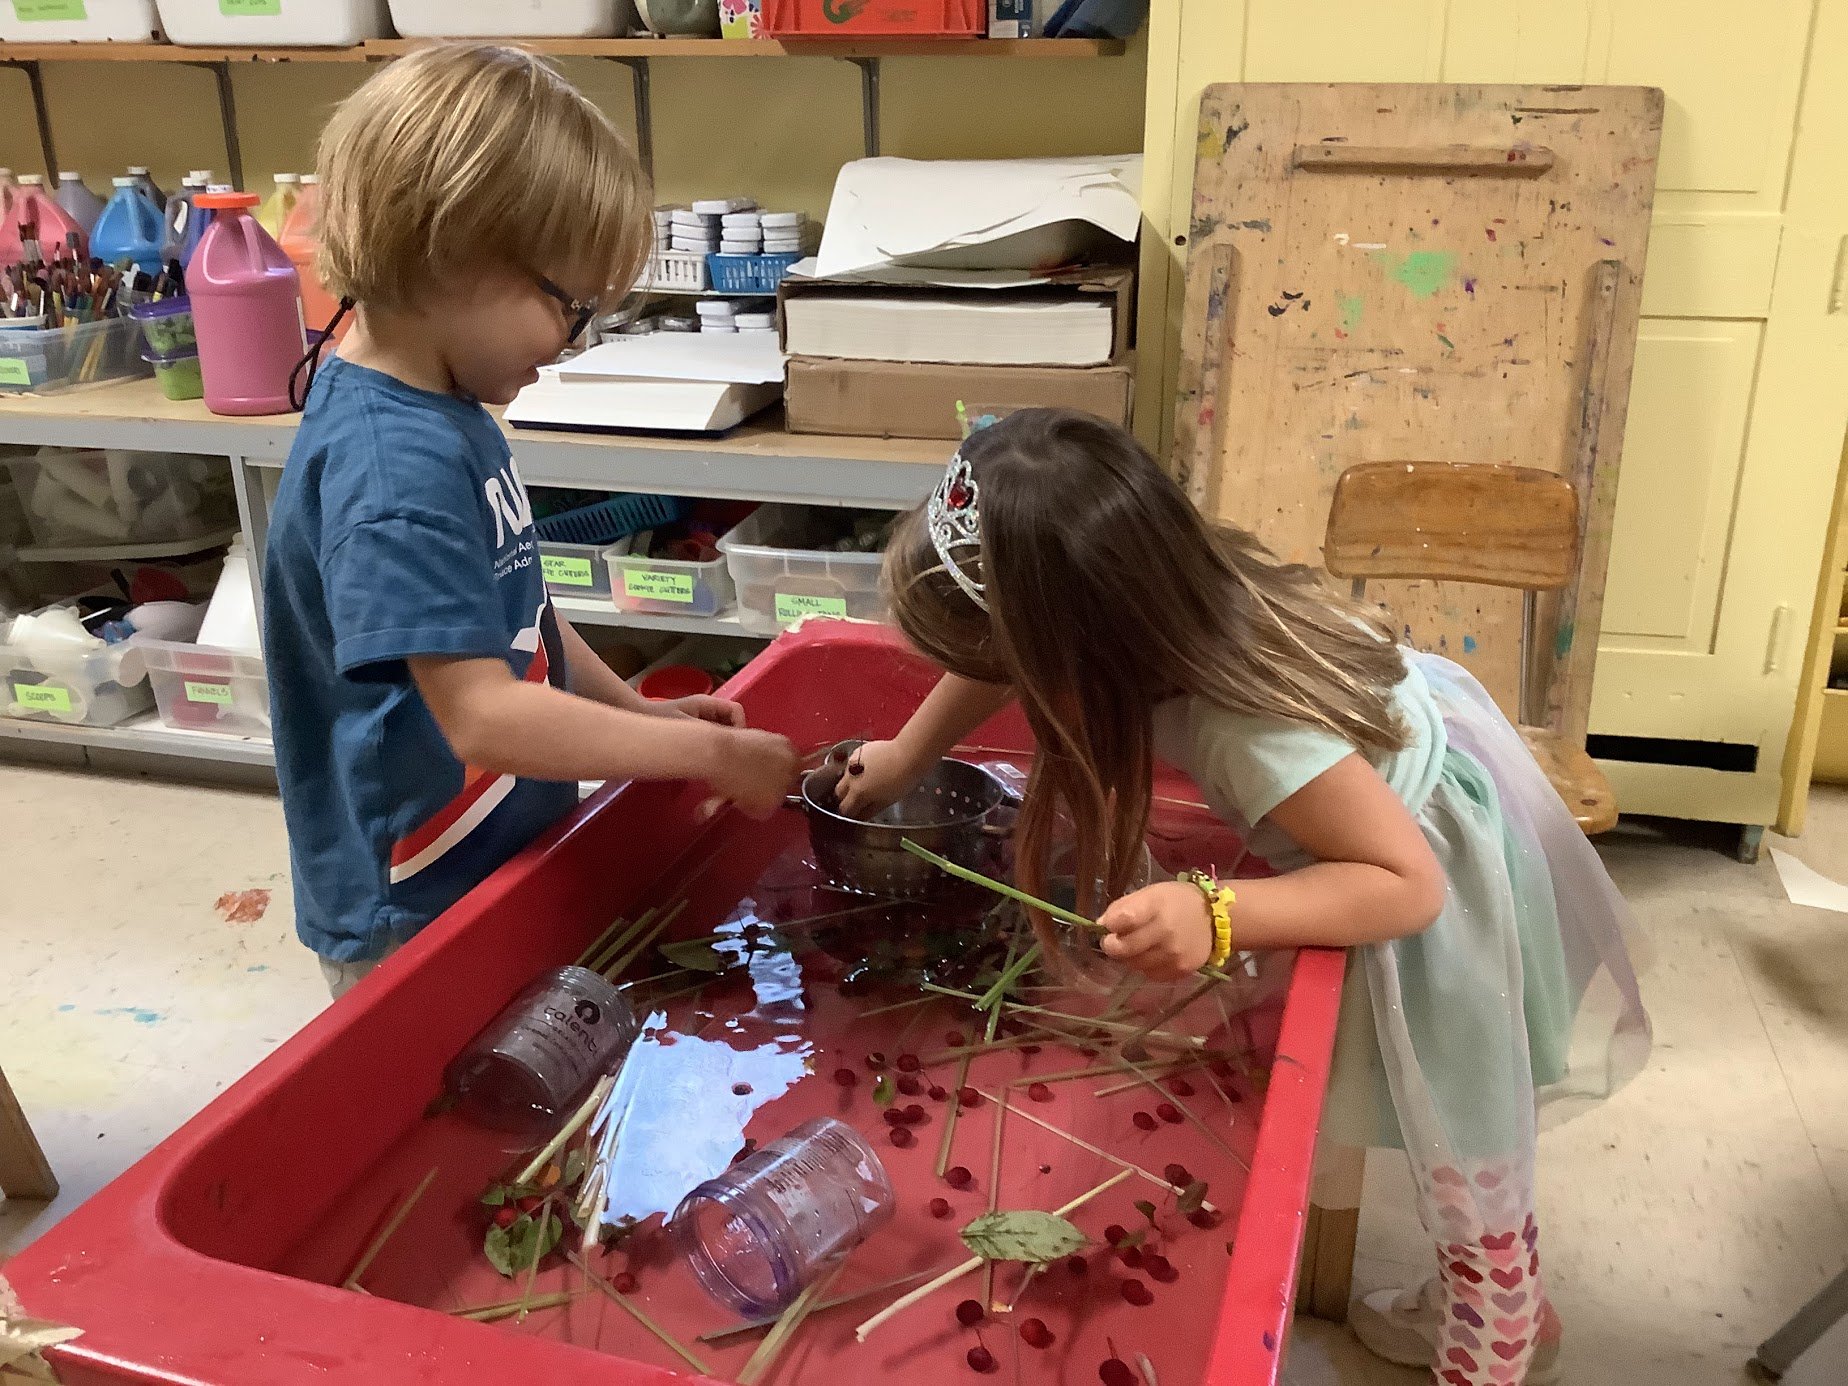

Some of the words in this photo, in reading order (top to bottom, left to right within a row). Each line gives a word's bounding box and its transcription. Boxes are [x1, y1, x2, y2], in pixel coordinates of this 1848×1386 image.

[641, 573, 676, 585] VARIETY
[628, 583, 655, 593] COOKIE
[658, 586, 691, 594] CUTTERS
[791, 598, 821, 607] SMALL
